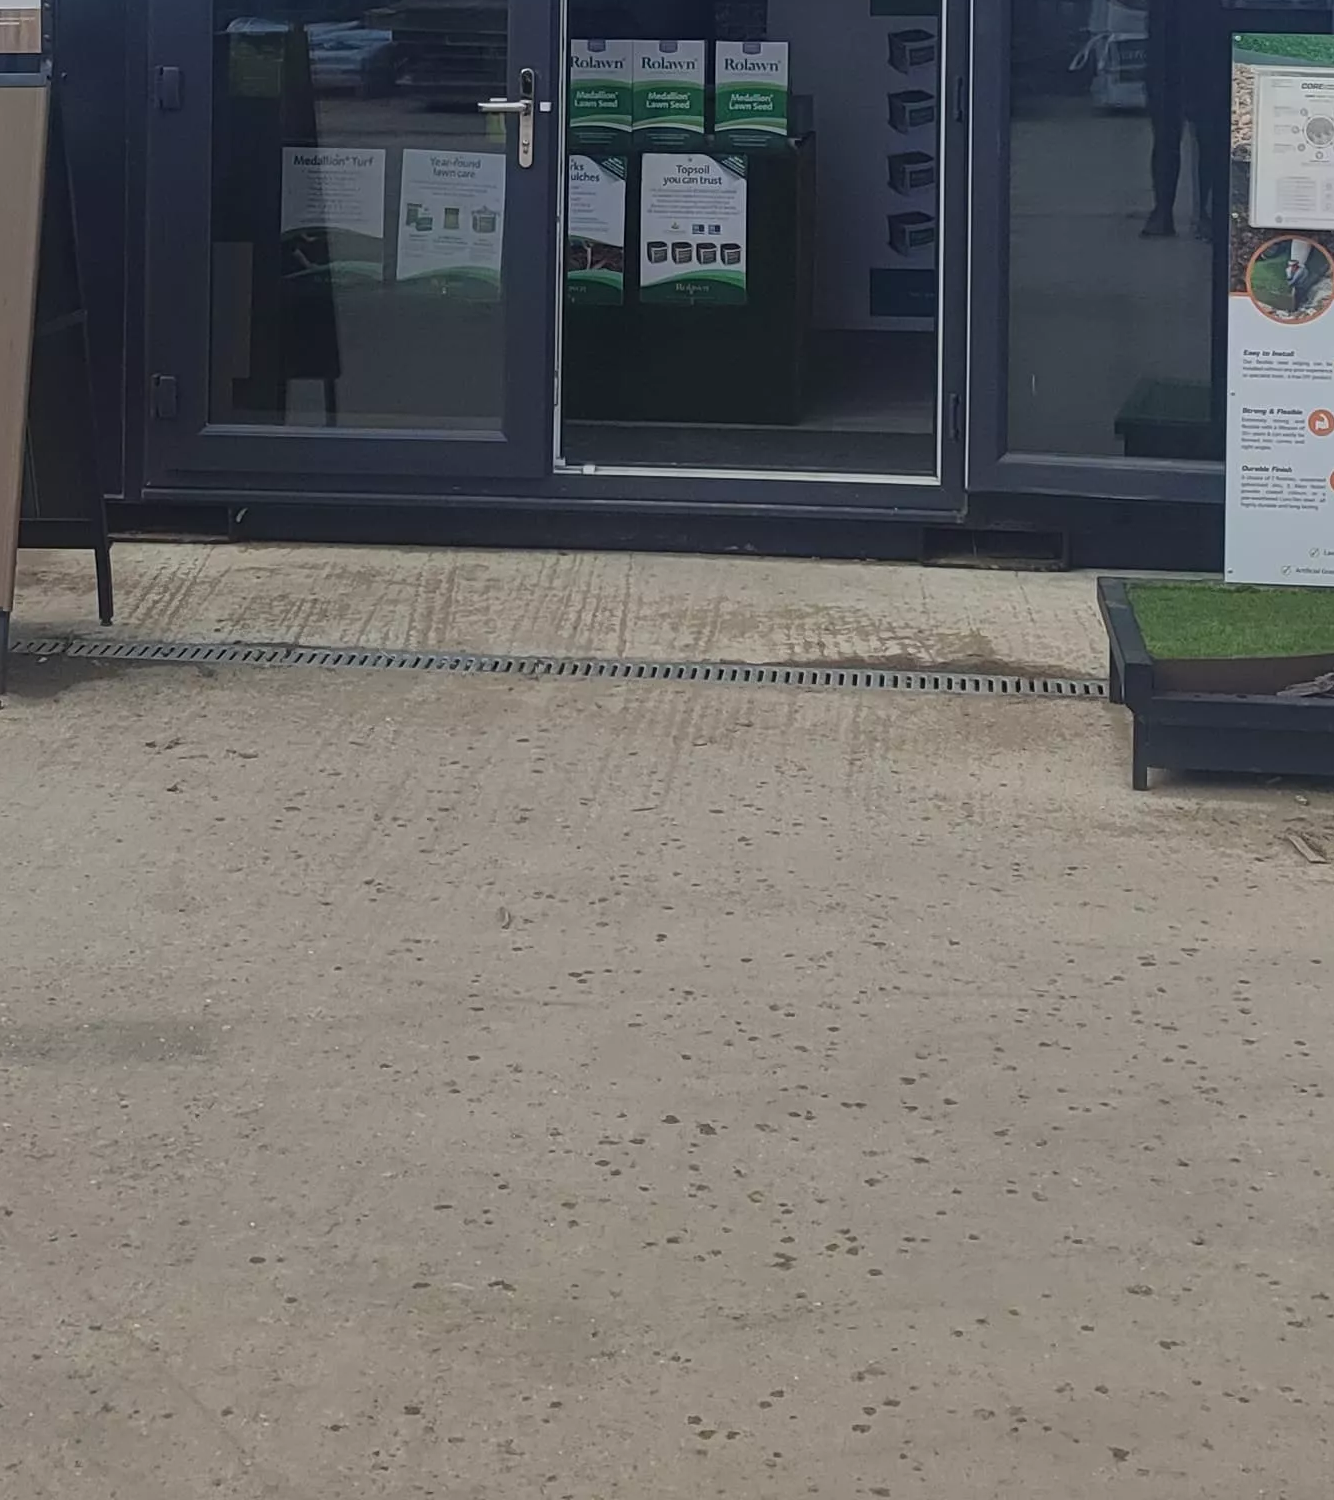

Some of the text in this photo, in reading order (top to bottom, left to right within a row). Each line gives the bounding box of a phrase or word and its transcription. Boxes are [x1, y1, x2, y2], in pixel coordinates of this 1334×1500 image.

[641, 56, 696, 70] Rolawn
[724, 58, 778, 72] Rolawn
[574, 99, 618, 108] Lawn Seed
[646, 100, 690, 109] Lawn Seed
[729, 101, 773, 111] Lawn Seed
[351, 156, 375, 167] Turf
[570, 162, 585, 171] rks
[676, 164, 710, 176] Topsoil
[570, 172, 600, 182] ulches
[662, 176, 722, 187] you can trust
[1243, 349, 1261, 357] Easy
[1242, 408, 1267, 416] Strong
